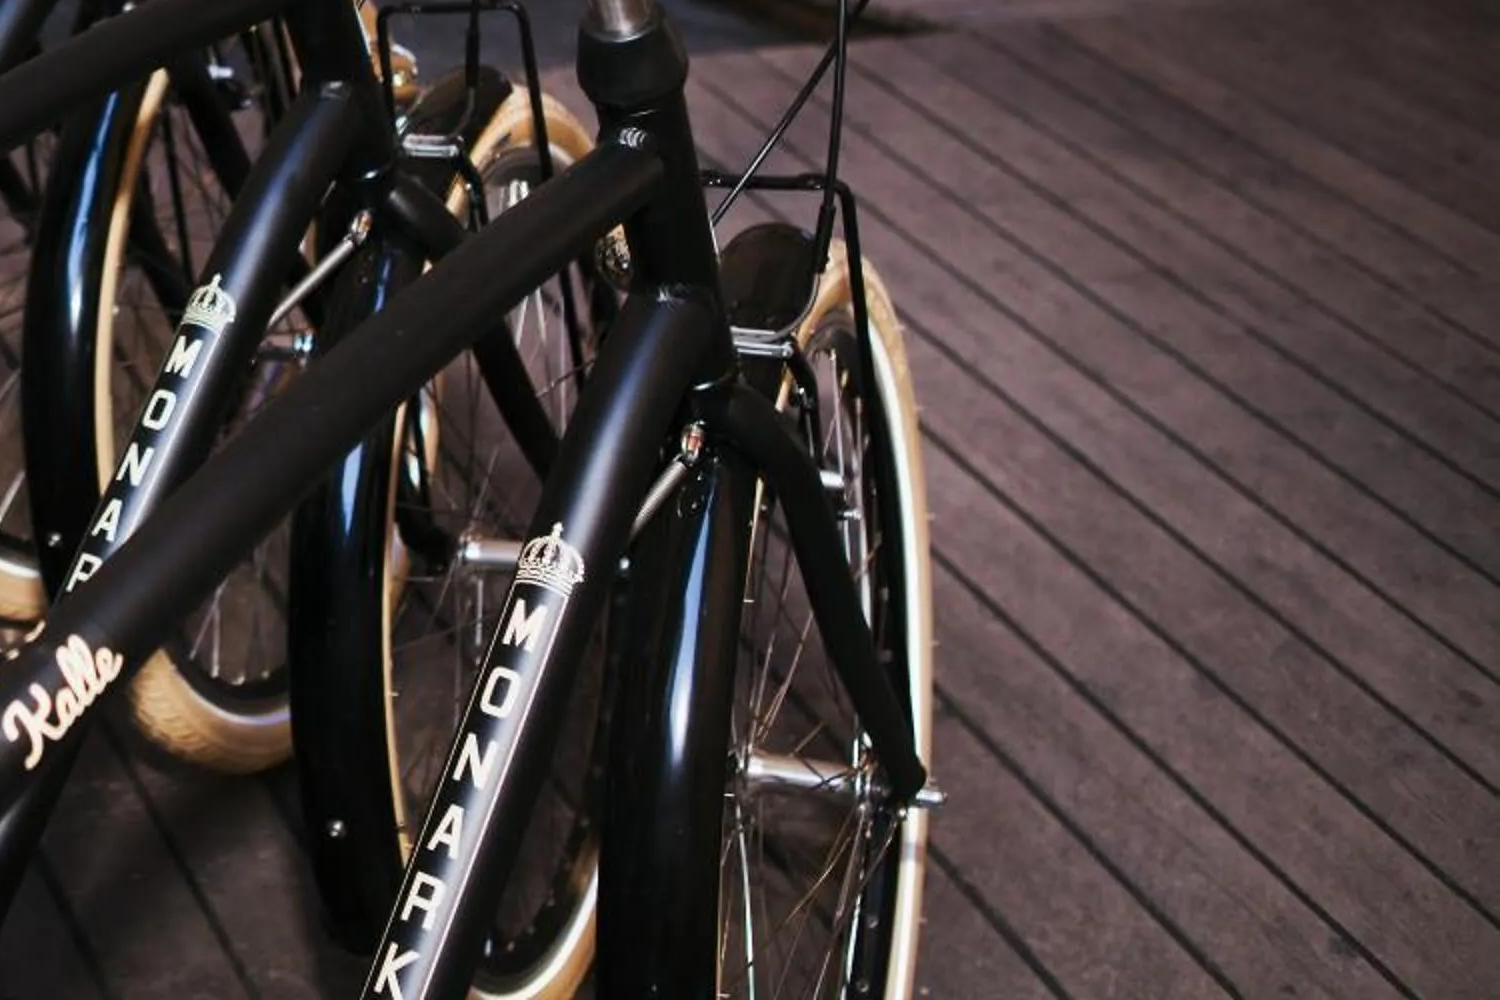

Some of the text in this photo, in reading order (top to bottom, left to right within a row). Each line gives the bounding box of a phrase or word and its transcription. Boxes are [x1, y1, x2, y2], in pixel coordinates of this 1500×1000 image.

[65, 336, 201, 592] MONAR
[2, 633, 124, 771] Kalle
[373, 598, 548, 1000] MONARK
